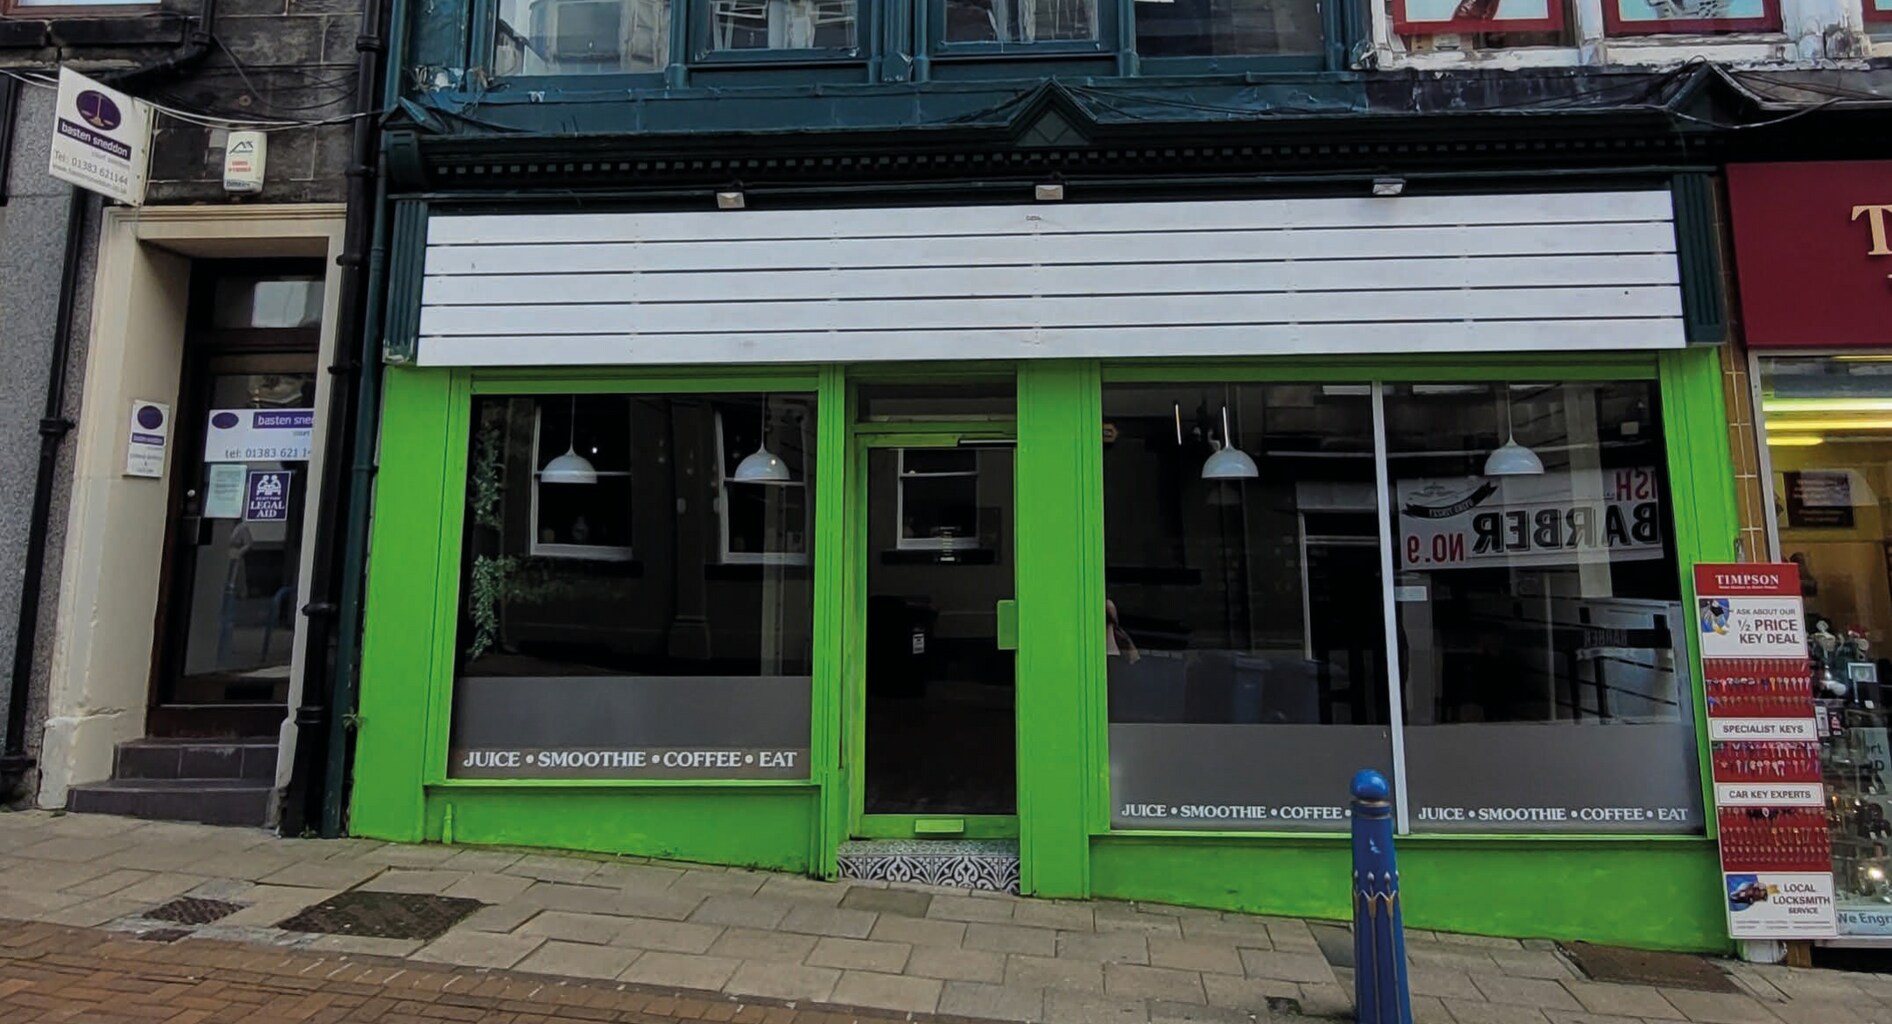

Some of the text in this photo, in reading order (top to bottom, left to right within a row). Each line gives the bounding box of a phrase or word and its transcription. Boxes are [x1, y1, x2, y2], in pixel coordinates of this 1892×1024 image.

[61, 121, 128, 157] basten sneddon
[71, 157, 97, 174] 01383
[99, 167, 128, 185] 621144
[257, 415, 291, 425] basten
[245, 448, 276, 458] 01383
[280, 448, 298, 458] 621
[250, 500, 285, 510] LEGAL
[256, 509, 278, 518] AID
[1715, 574, 1779, 585] TIMPSON
[1754, 619, 1798, 631] PRICE
[1739, 633, 1800, 644] KEY DEAL
[1723, 724, 1804, 734] SPECIALIST KEYS
[463, 750, 797, 767] JUICE SMOOTHIE COFFEE EAT
[1729, 790, 1812, 799] CAR KEY EXPERTS
[1121, 804, 1343, 819] JUICE SMOOTHIE COFFEE
[1418, 807, 1688, 821] JUICE SMOOTHIE COFFEE EAT
[1783, 883, 1816, 893] LOCAL
[1773, 896, 1831, 905] LOCKSMITH
[1788, 907, 1819, 915] SERVICE
[1838, 913, 1858, 923] We
